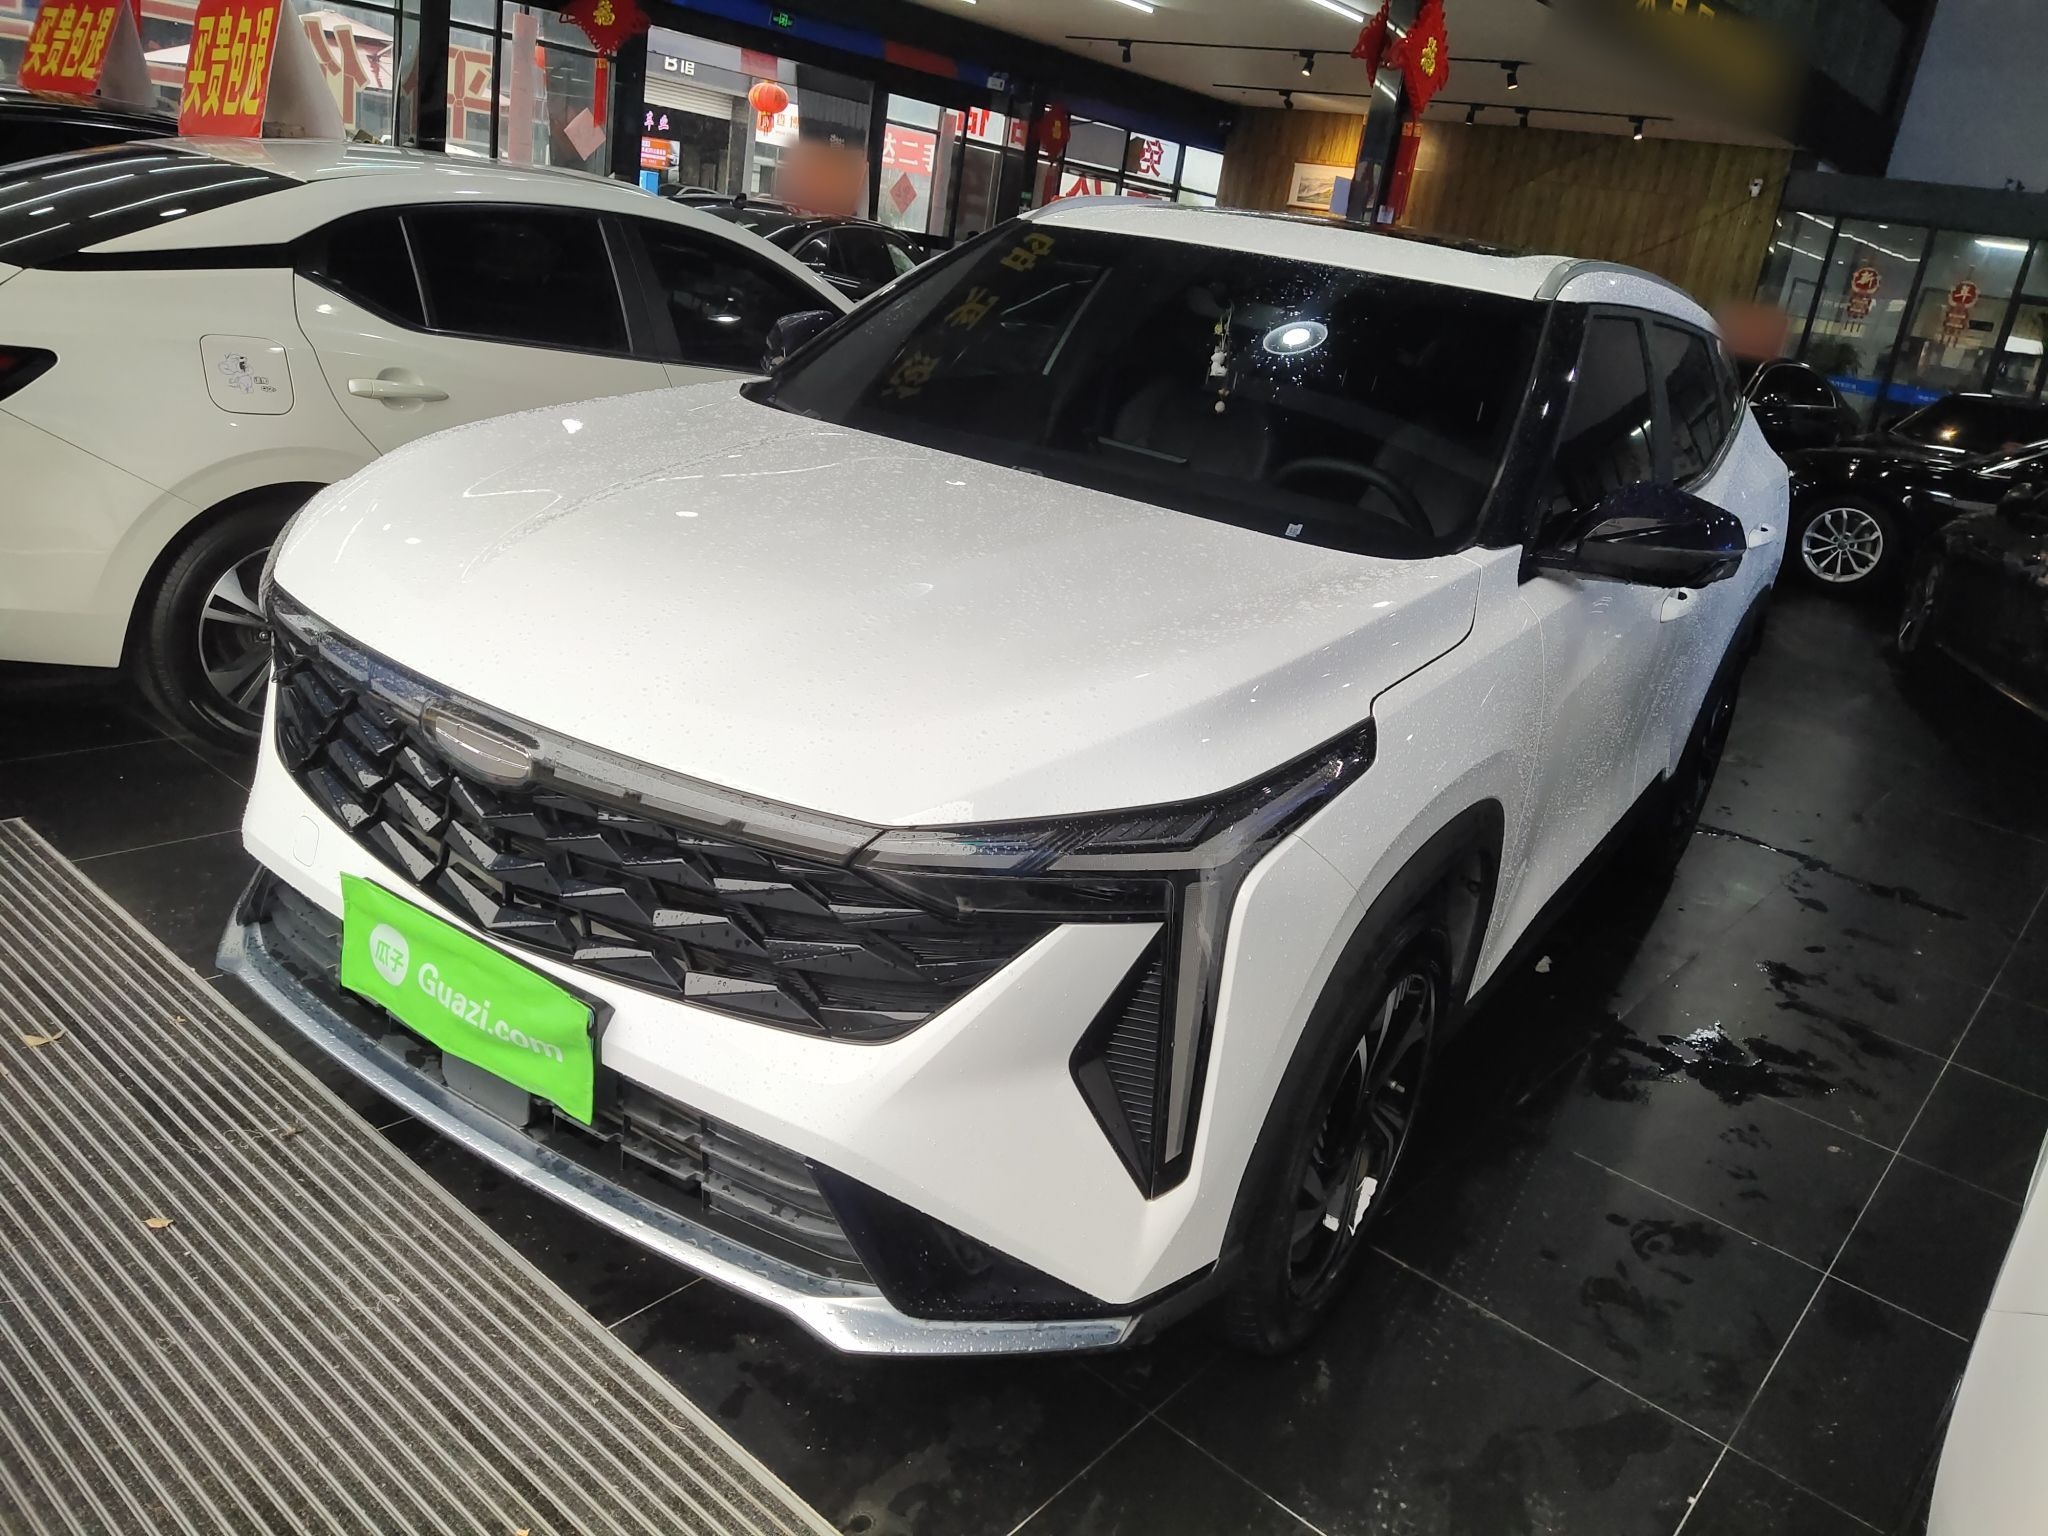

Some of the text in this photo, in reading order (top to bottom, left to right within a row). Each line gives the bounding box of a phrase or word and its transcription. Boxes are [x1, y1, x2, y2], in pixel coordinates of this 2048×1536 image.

[23, 5, 115, 79] 买贵包退
[183, 5, 274, 117] 买贵包退
[375, 938, 564, 1064] 瓜子 Guazi.com
